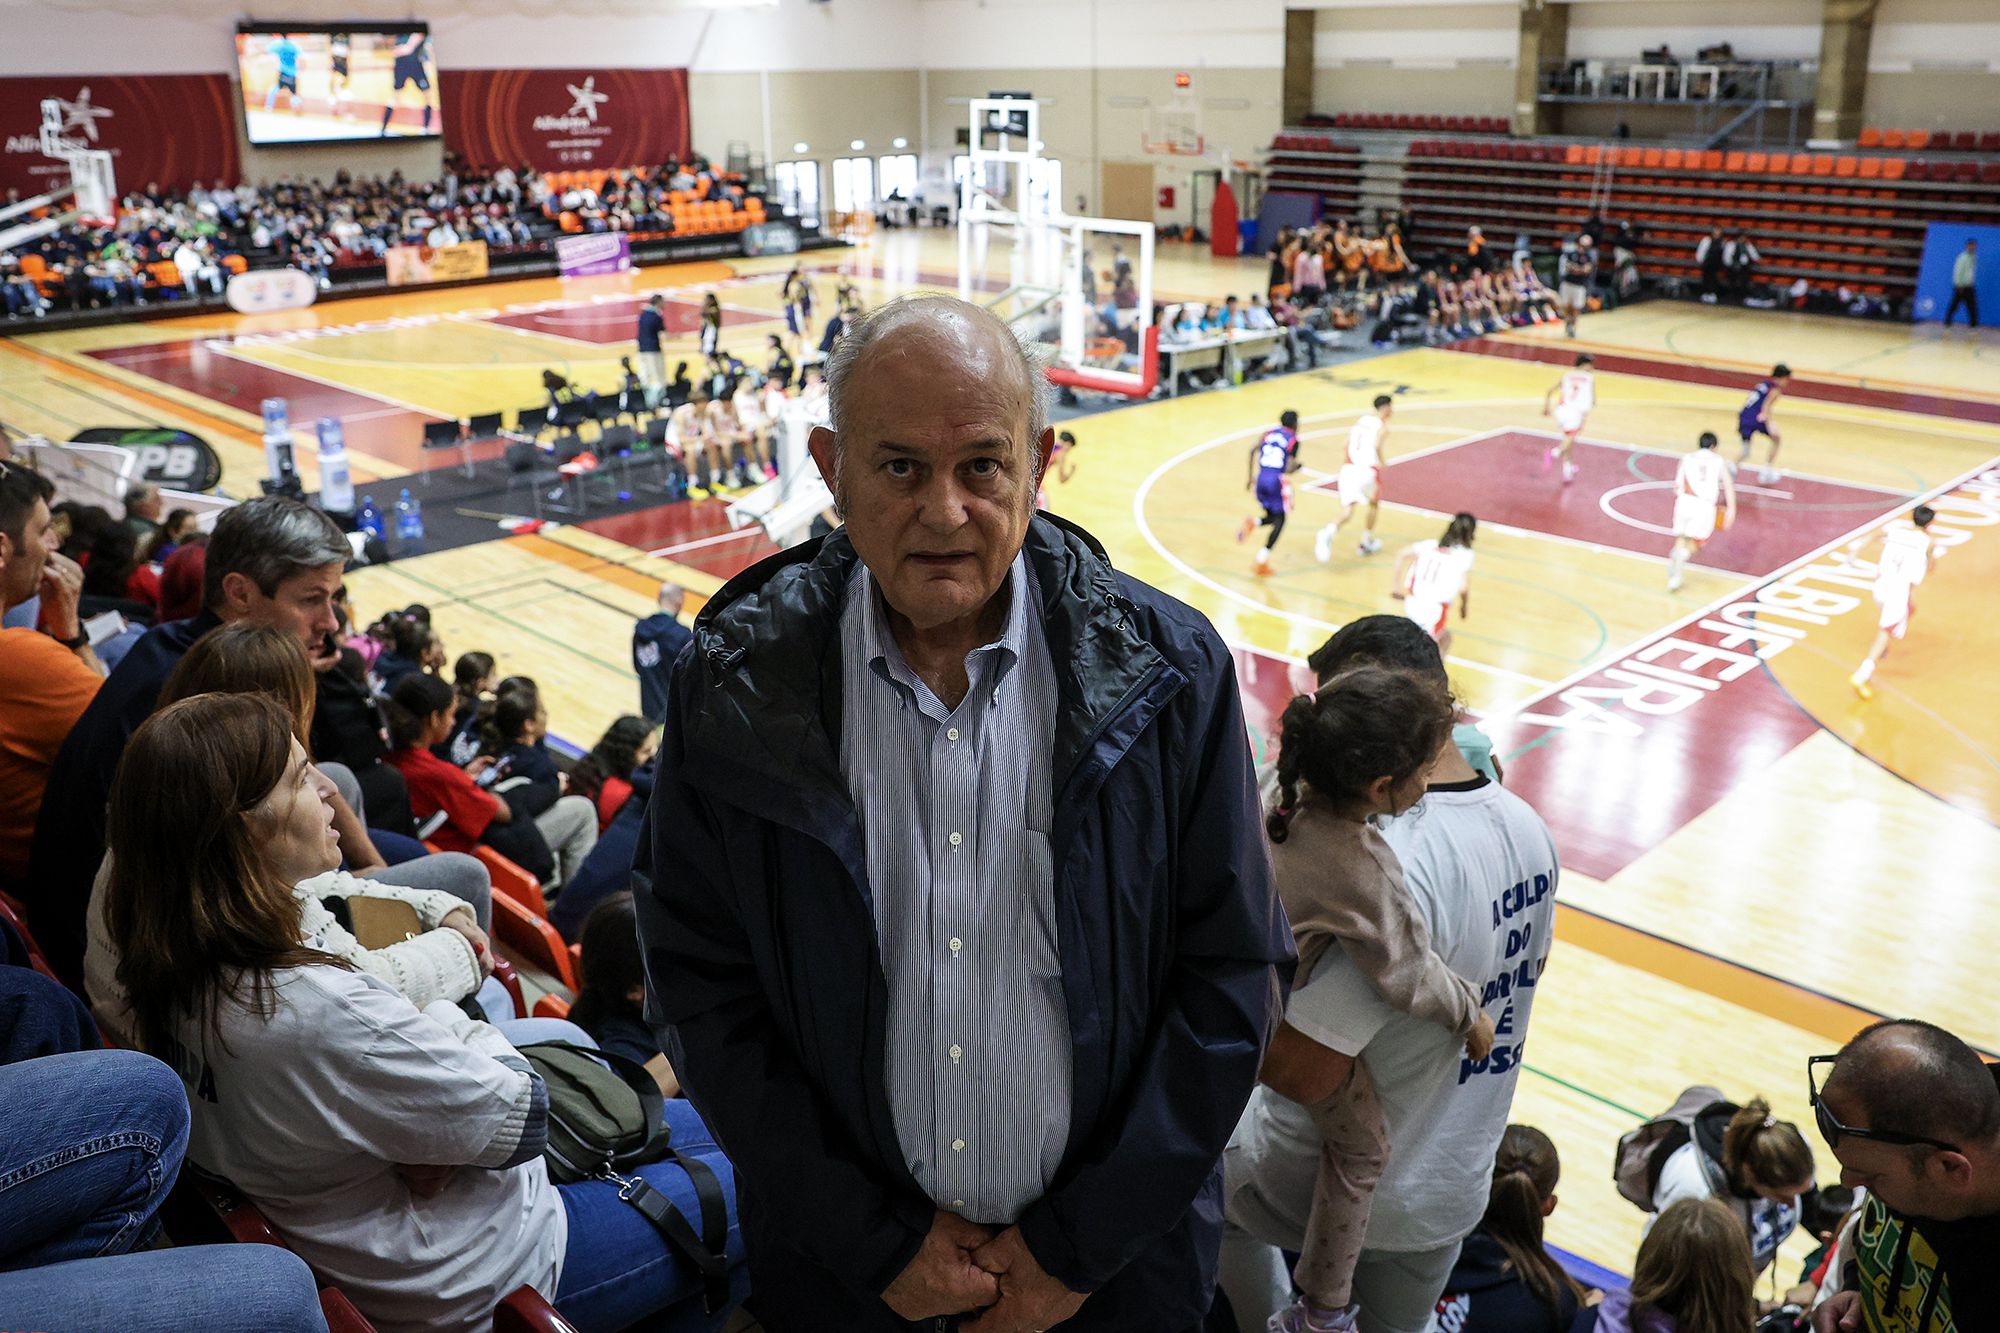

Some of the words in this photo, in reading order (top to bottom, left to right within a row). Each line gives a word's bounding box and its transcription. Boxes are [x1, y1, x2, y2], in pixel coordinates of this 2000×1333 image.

[1493, 899, 1501, 932] A
[1505, 921, 1532, 959] DO
[1495, 997, 1514, 1035] É
